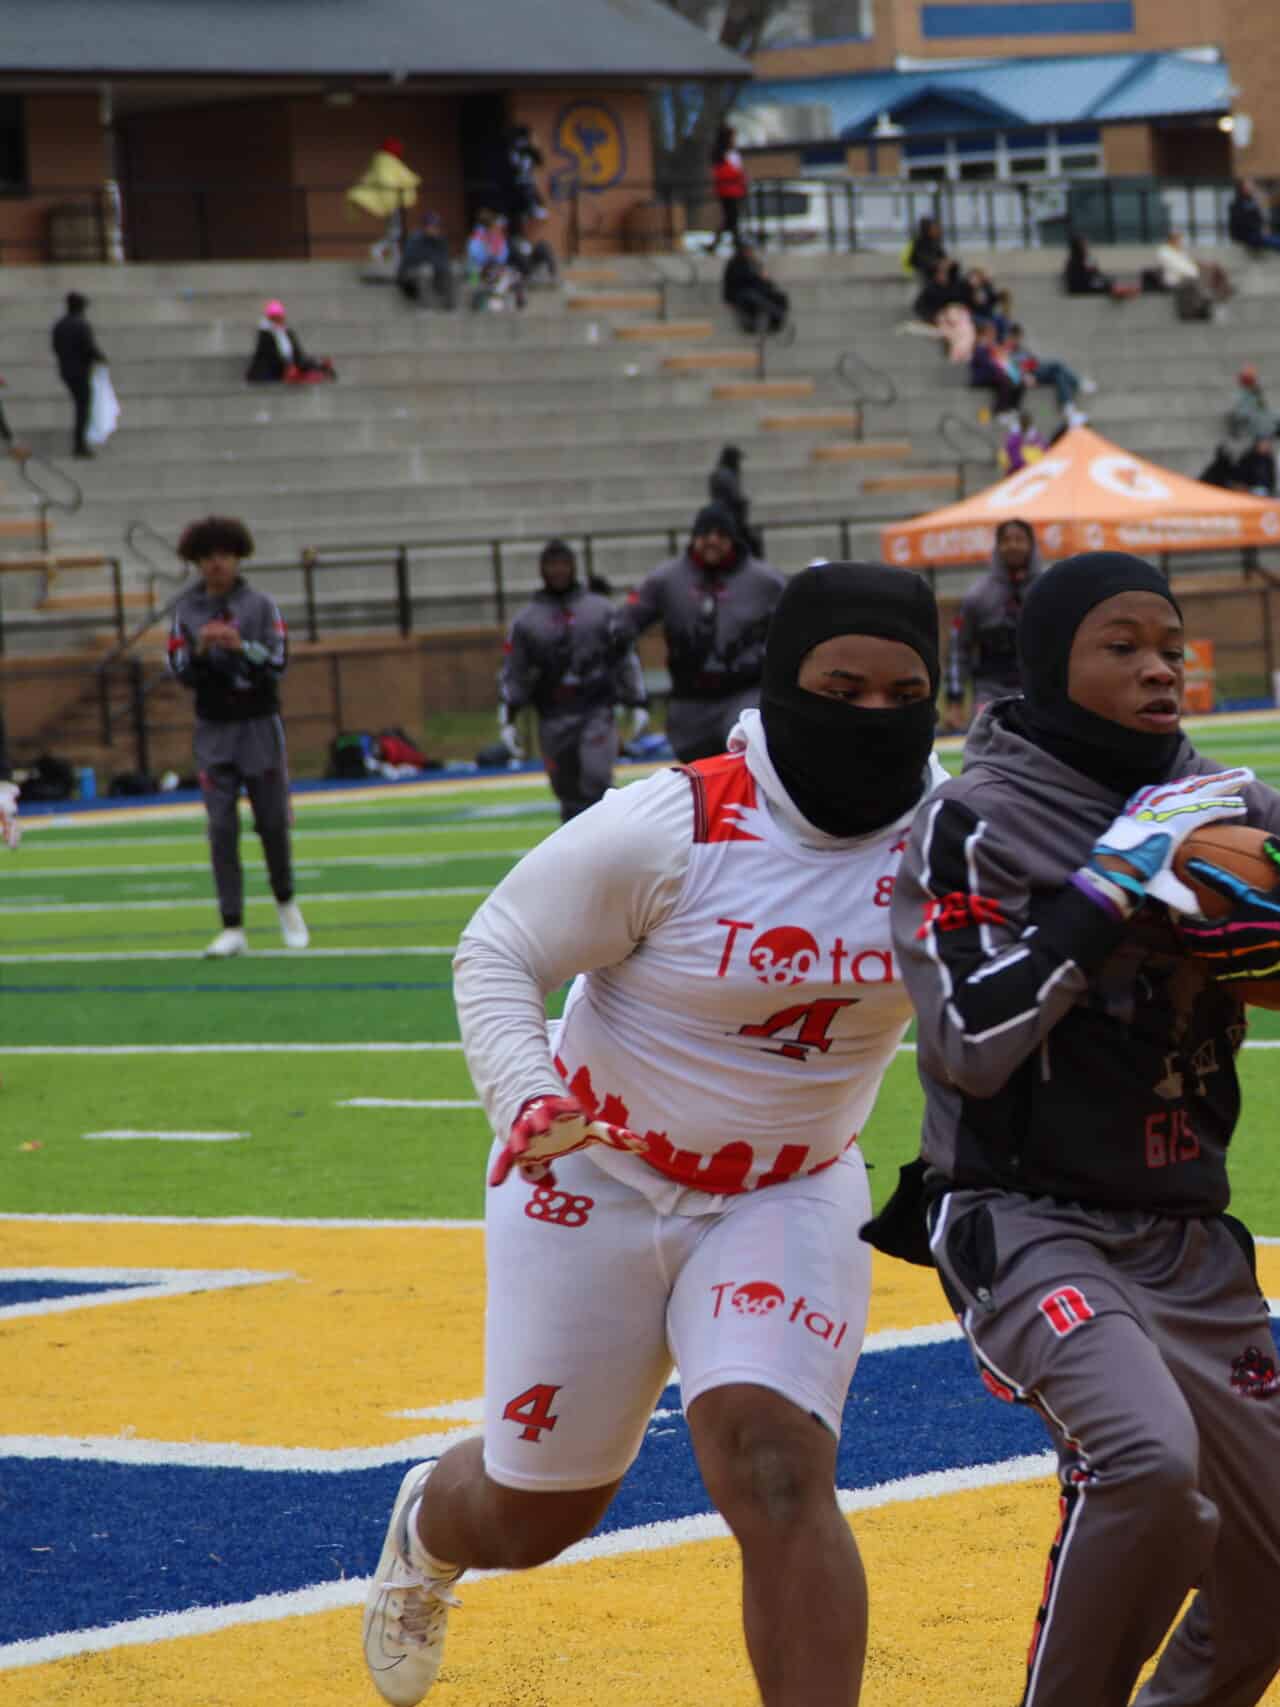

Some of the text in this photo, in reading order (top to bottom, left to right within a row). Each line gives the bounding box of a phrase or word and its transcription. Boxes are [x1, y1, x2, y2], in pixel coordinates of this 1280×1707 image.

[873, 875, 895, 908] 8
[716, 918, 893, 985] Tota
[726, 997, 860, 1062] 4
[502, 1383, 562, 1443] 4
